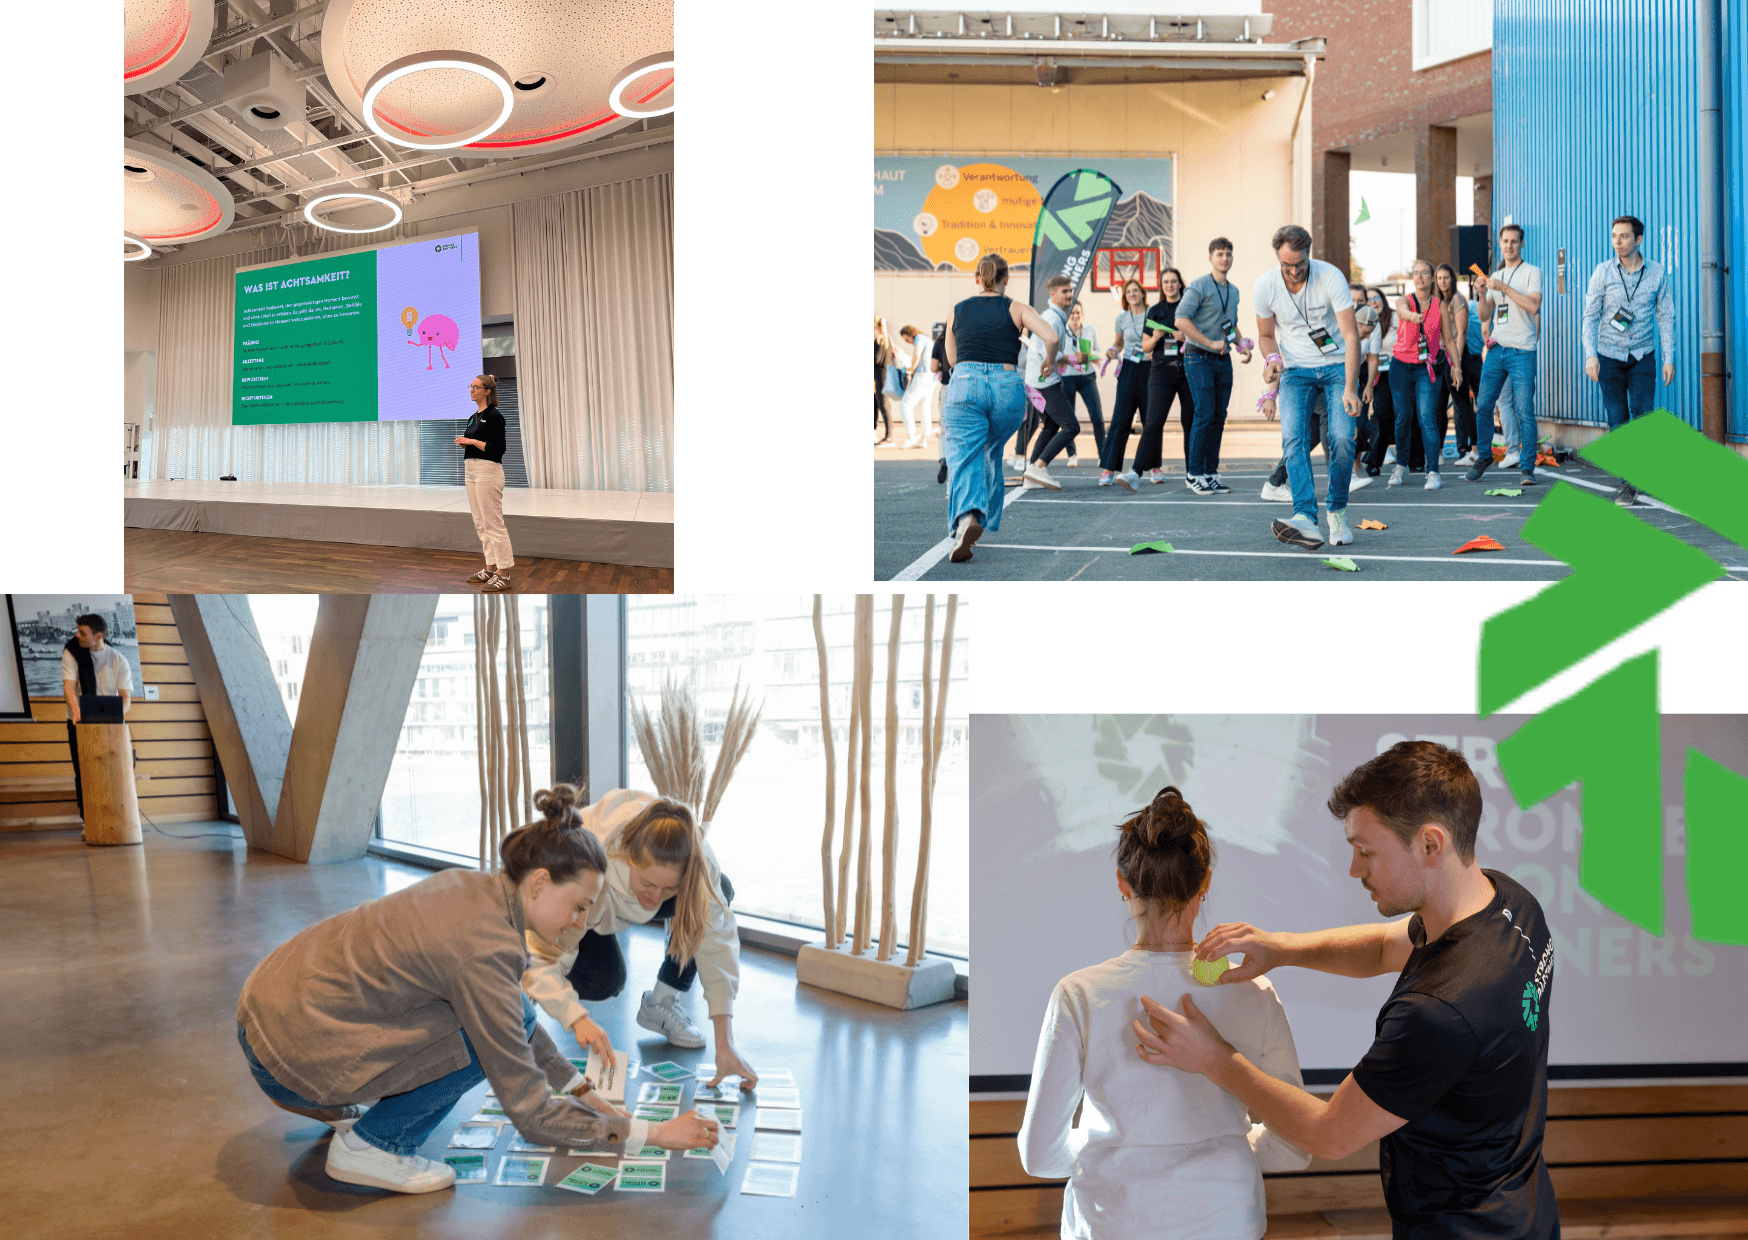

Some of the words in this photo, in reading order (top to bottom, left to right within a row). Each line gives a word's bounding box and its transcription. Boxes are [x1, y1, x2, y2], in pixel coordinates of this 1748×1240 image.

[962, 172, 1038, 183] Verantwortung
[1003, 198, 1037, 206] mutige
[942, 220, 986, 229] Tradition
[989, 220, 997, 229] &
[244, 283, 264, 294] WAS
[265, 281, 279, 291] IST
[280, 270, 350, 289] ACHTSAMKEIT?
